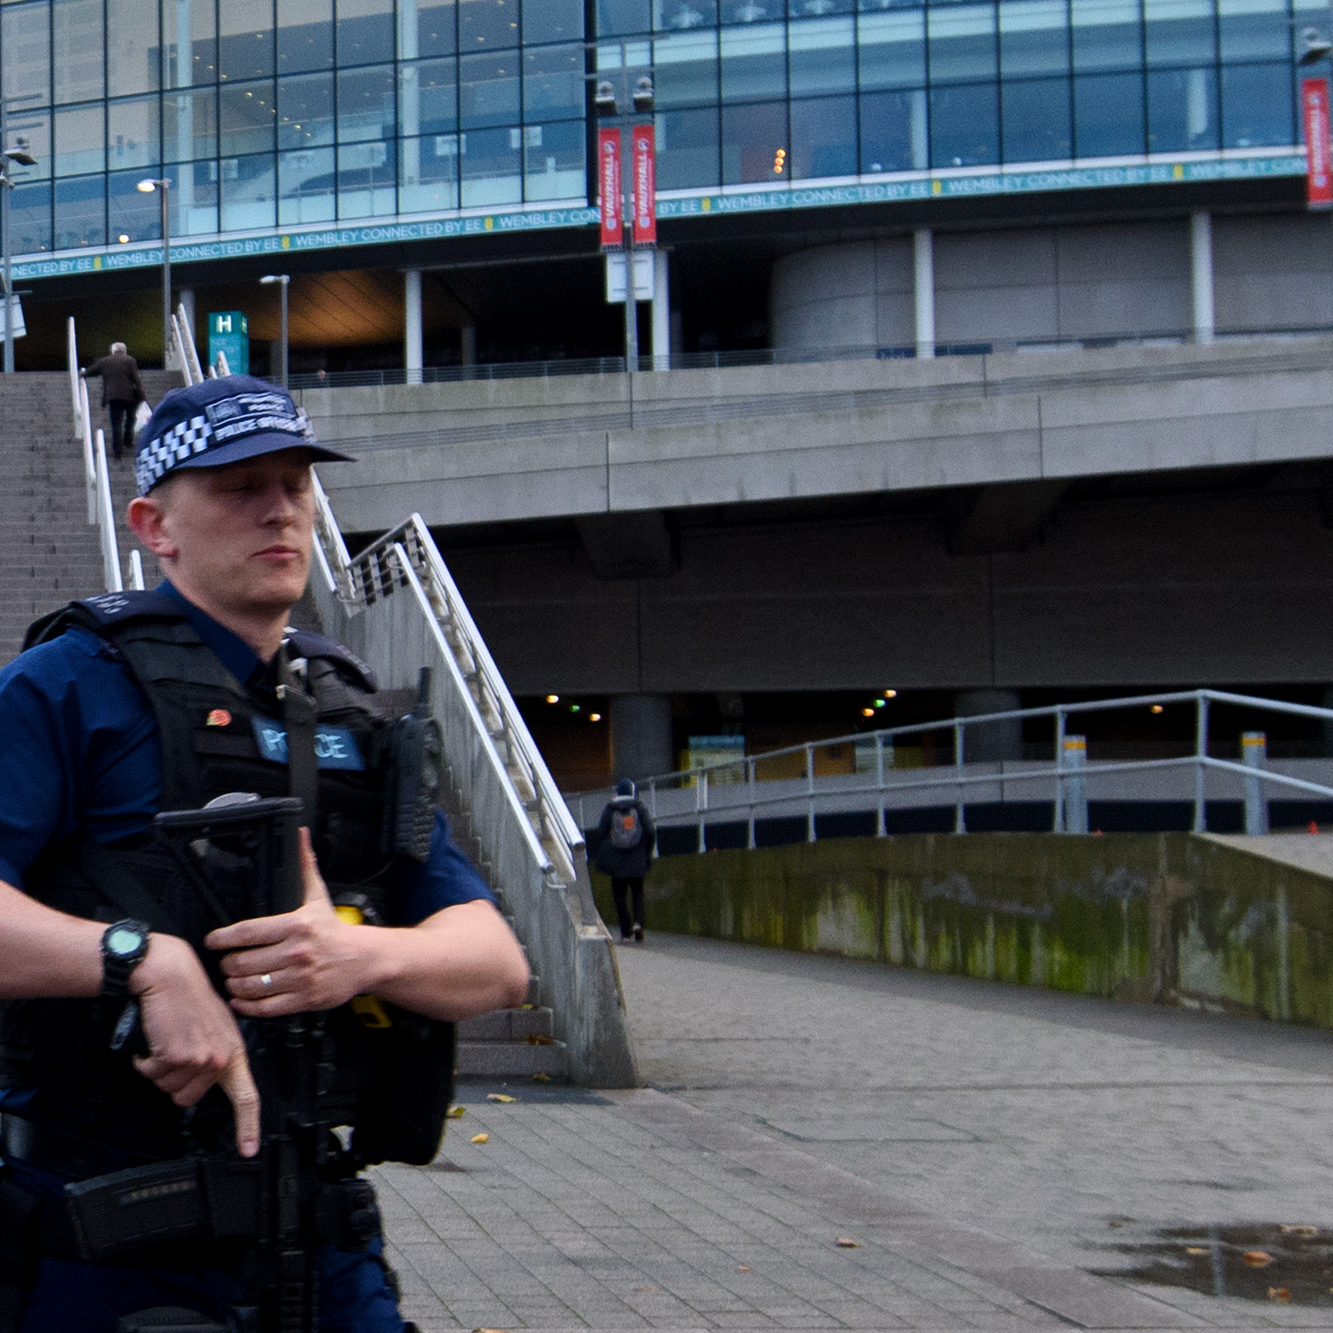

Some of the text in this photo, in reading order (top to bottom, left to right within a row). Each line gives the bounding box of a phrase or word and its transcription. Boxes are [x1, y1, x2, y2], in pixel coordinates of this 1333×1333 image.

[604, 154, 615, 217] VAUXHALL
[638, 152, 649, 215] VAUXHALL
[718, 181, 928, 209] WEMBLEY CONNECTED BY EE
[499, 211, 567, 228] WEMBLEY
[659, 200, 698, 215] BY EE
[295, 218, 481, 246] WEMBLEY CONNECTED BY EE
[60, 259, 77, 272] BY
[77, 257, 91, 270] EE
[106, 238, 278, 266] WEMBLEY CONNECTED BY EE
[216, 315, 232, 333] H
[262, 729, 349, 758] PCE
